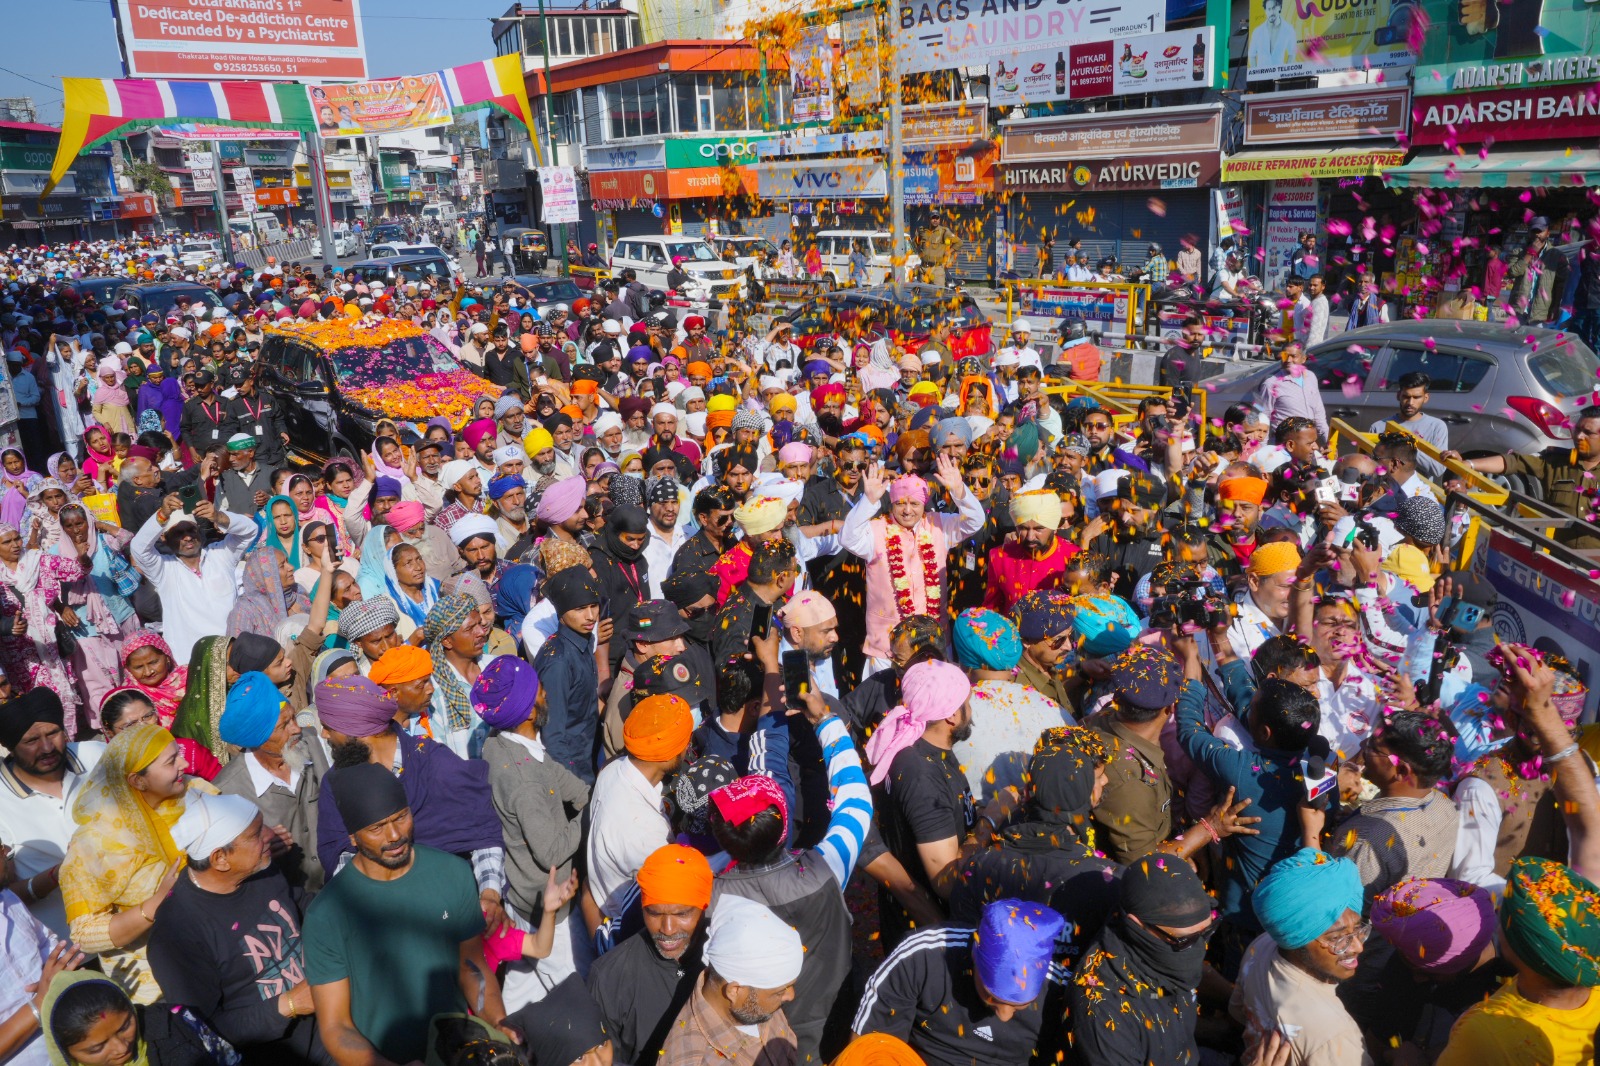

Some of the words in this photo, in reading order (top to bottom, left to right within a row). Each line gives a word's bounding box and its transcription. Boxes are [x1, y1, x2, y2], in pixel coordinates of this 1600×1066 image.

[138, 5, 213, 22] Dedicated
[215, 9, 302, 27] De-addiction
[305, 15, 348, 28] Centre
[900, 0, 970, 30] BAGS
[1334, 11, 1347, 20] BORN
[1355, 9, 1362, 18] BE
[1363, 7, 1376, 17] FREE
[160, 21, 223, 37] Founded
[225, 24, 243, 40] by
[247, 30, 256, 39] a
[258, 27, 336, 43] Psychiatrist
[946, 6, 1087, 52] LAUNDRY
[1109, 22, 1148, 34] DEHRADUN'S
[177, 52, 209, 60] Chakrata
[210, 53, 228, 61] Road
[229, 54, 248, 62] (Near
[267, 56, 296, 64] Ramada)
[1076, 53, 1107, 65] HITKARI
[223, 62, 284, 74] 9258253650,
[286, 64, 298, 73] 51
[1071, 64, 1113, 77] AYURVEDIC
[1248, 66, 1277, 76] ASHIRWAD
[1277, 64, 1303, 72] TELECOM
[1453, 62, 1523, 90] ADARSH
[1527, 55, 1600, 83] BAKERS
[1423, 98, 1532, 127] ADARSH
[1536, 93, 1600, 120] BAK
[1034, 130, 1068, 145] हितकारी
[24, 151, 53, 166] oppo
[608, 148, 638, 167] vivo
[699, 141, 758, 161] oppo
[1225, 160, 1263, 173] MOBILE
[1265, 157, 1318, 171] REPARING
[1319, 156, 1328, 168] &
[1328, 154, 1405, 168] ACCESSORIES
[792, 169, 842, 189] vivo
[903, 167, 935, 178] MSUNG
[1005, 167, 1067, 185] HITKARI
[1098, 160, 1201, 184] AYURVEDIC
[1310, 168, 1319, 176] All
[1318, 167, 1337, 175] Mobile
[1337, 167, 1352, 175] Parts
[687, 173, 722, 188] शाओमी
[1275, 178, 1306, 188] REPARING
[1269, 209, 1288, 219] Repair
[1293, 208, 1316, 219] Service
[1276, 226, 1293, 234] Mobile
[1294, 225, 1307, 234] Parts
[1271, 235, 1297, 243] Wholesale
